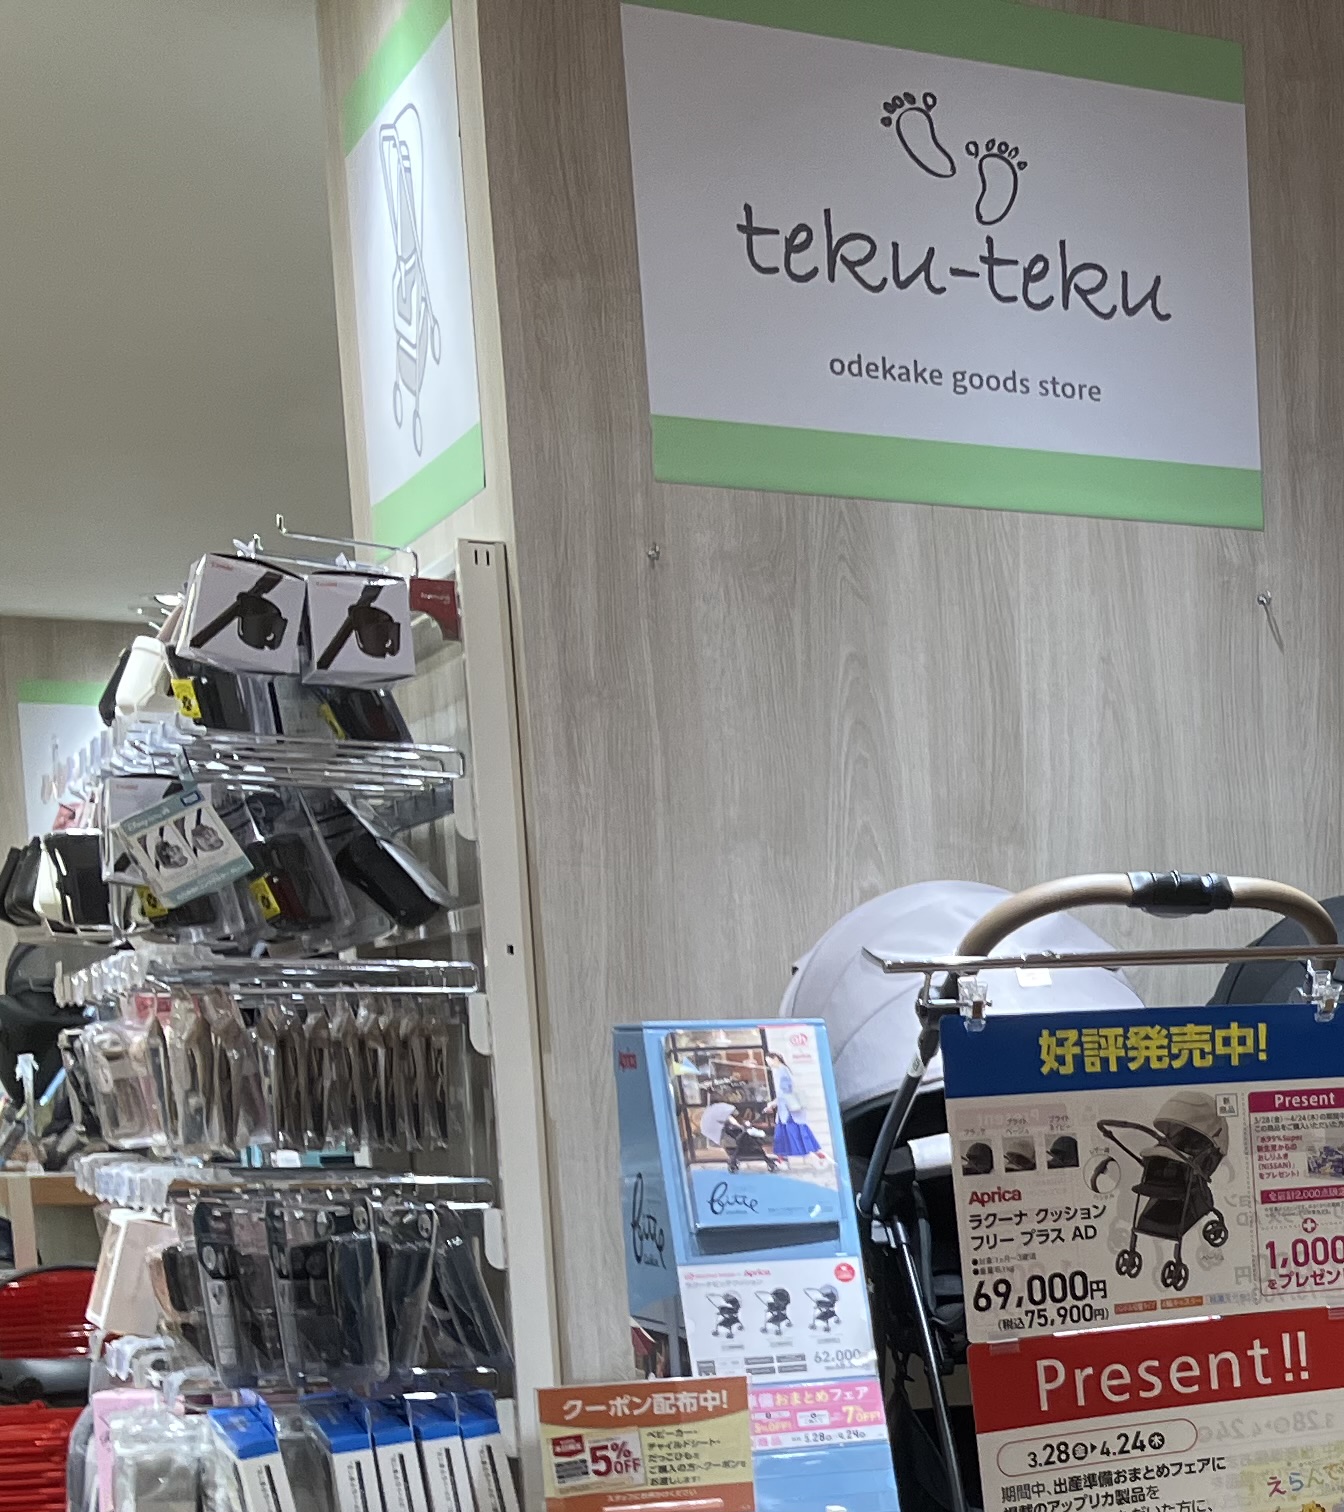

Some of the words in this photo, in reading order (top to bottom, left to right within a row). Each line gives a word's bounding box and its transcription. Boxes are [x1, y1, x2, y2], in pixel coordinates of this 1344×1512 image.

[737, 203, 1171, 321] teku-teku
[829, 354, 943, 388] odekake
[952, 368, 1030, 395] goods
[1038, 375, 1101, 402] store
[1038, 1022, 1269, 1076] 好評発売中!
[1275, 1092, 1335, 1108] Present
[968, 1186, 1022, 1207] Aprica
[968, 1209, 1029, 1230] ラクーナ
[1035, 1204, 1107, 1225] クッション
[971, 1234, 1015, 1252] フリー
[1021, 1227, 1066, 1247] プラス
[1071, 1225, 1098, 1242] AD
[973, 1270, 1108, 1313] 69,000円
[1036, 1331, 1310, 1412] Present!!
[563, 1389, 729, 1421] クーポン配布中!
[613, 1457, 641, 1475] OFF
[1001, 1455, 1228, 1503] 期間中、出産準備おまとめフェアに
[1266, 1461, 1344, 1498] えらんで
